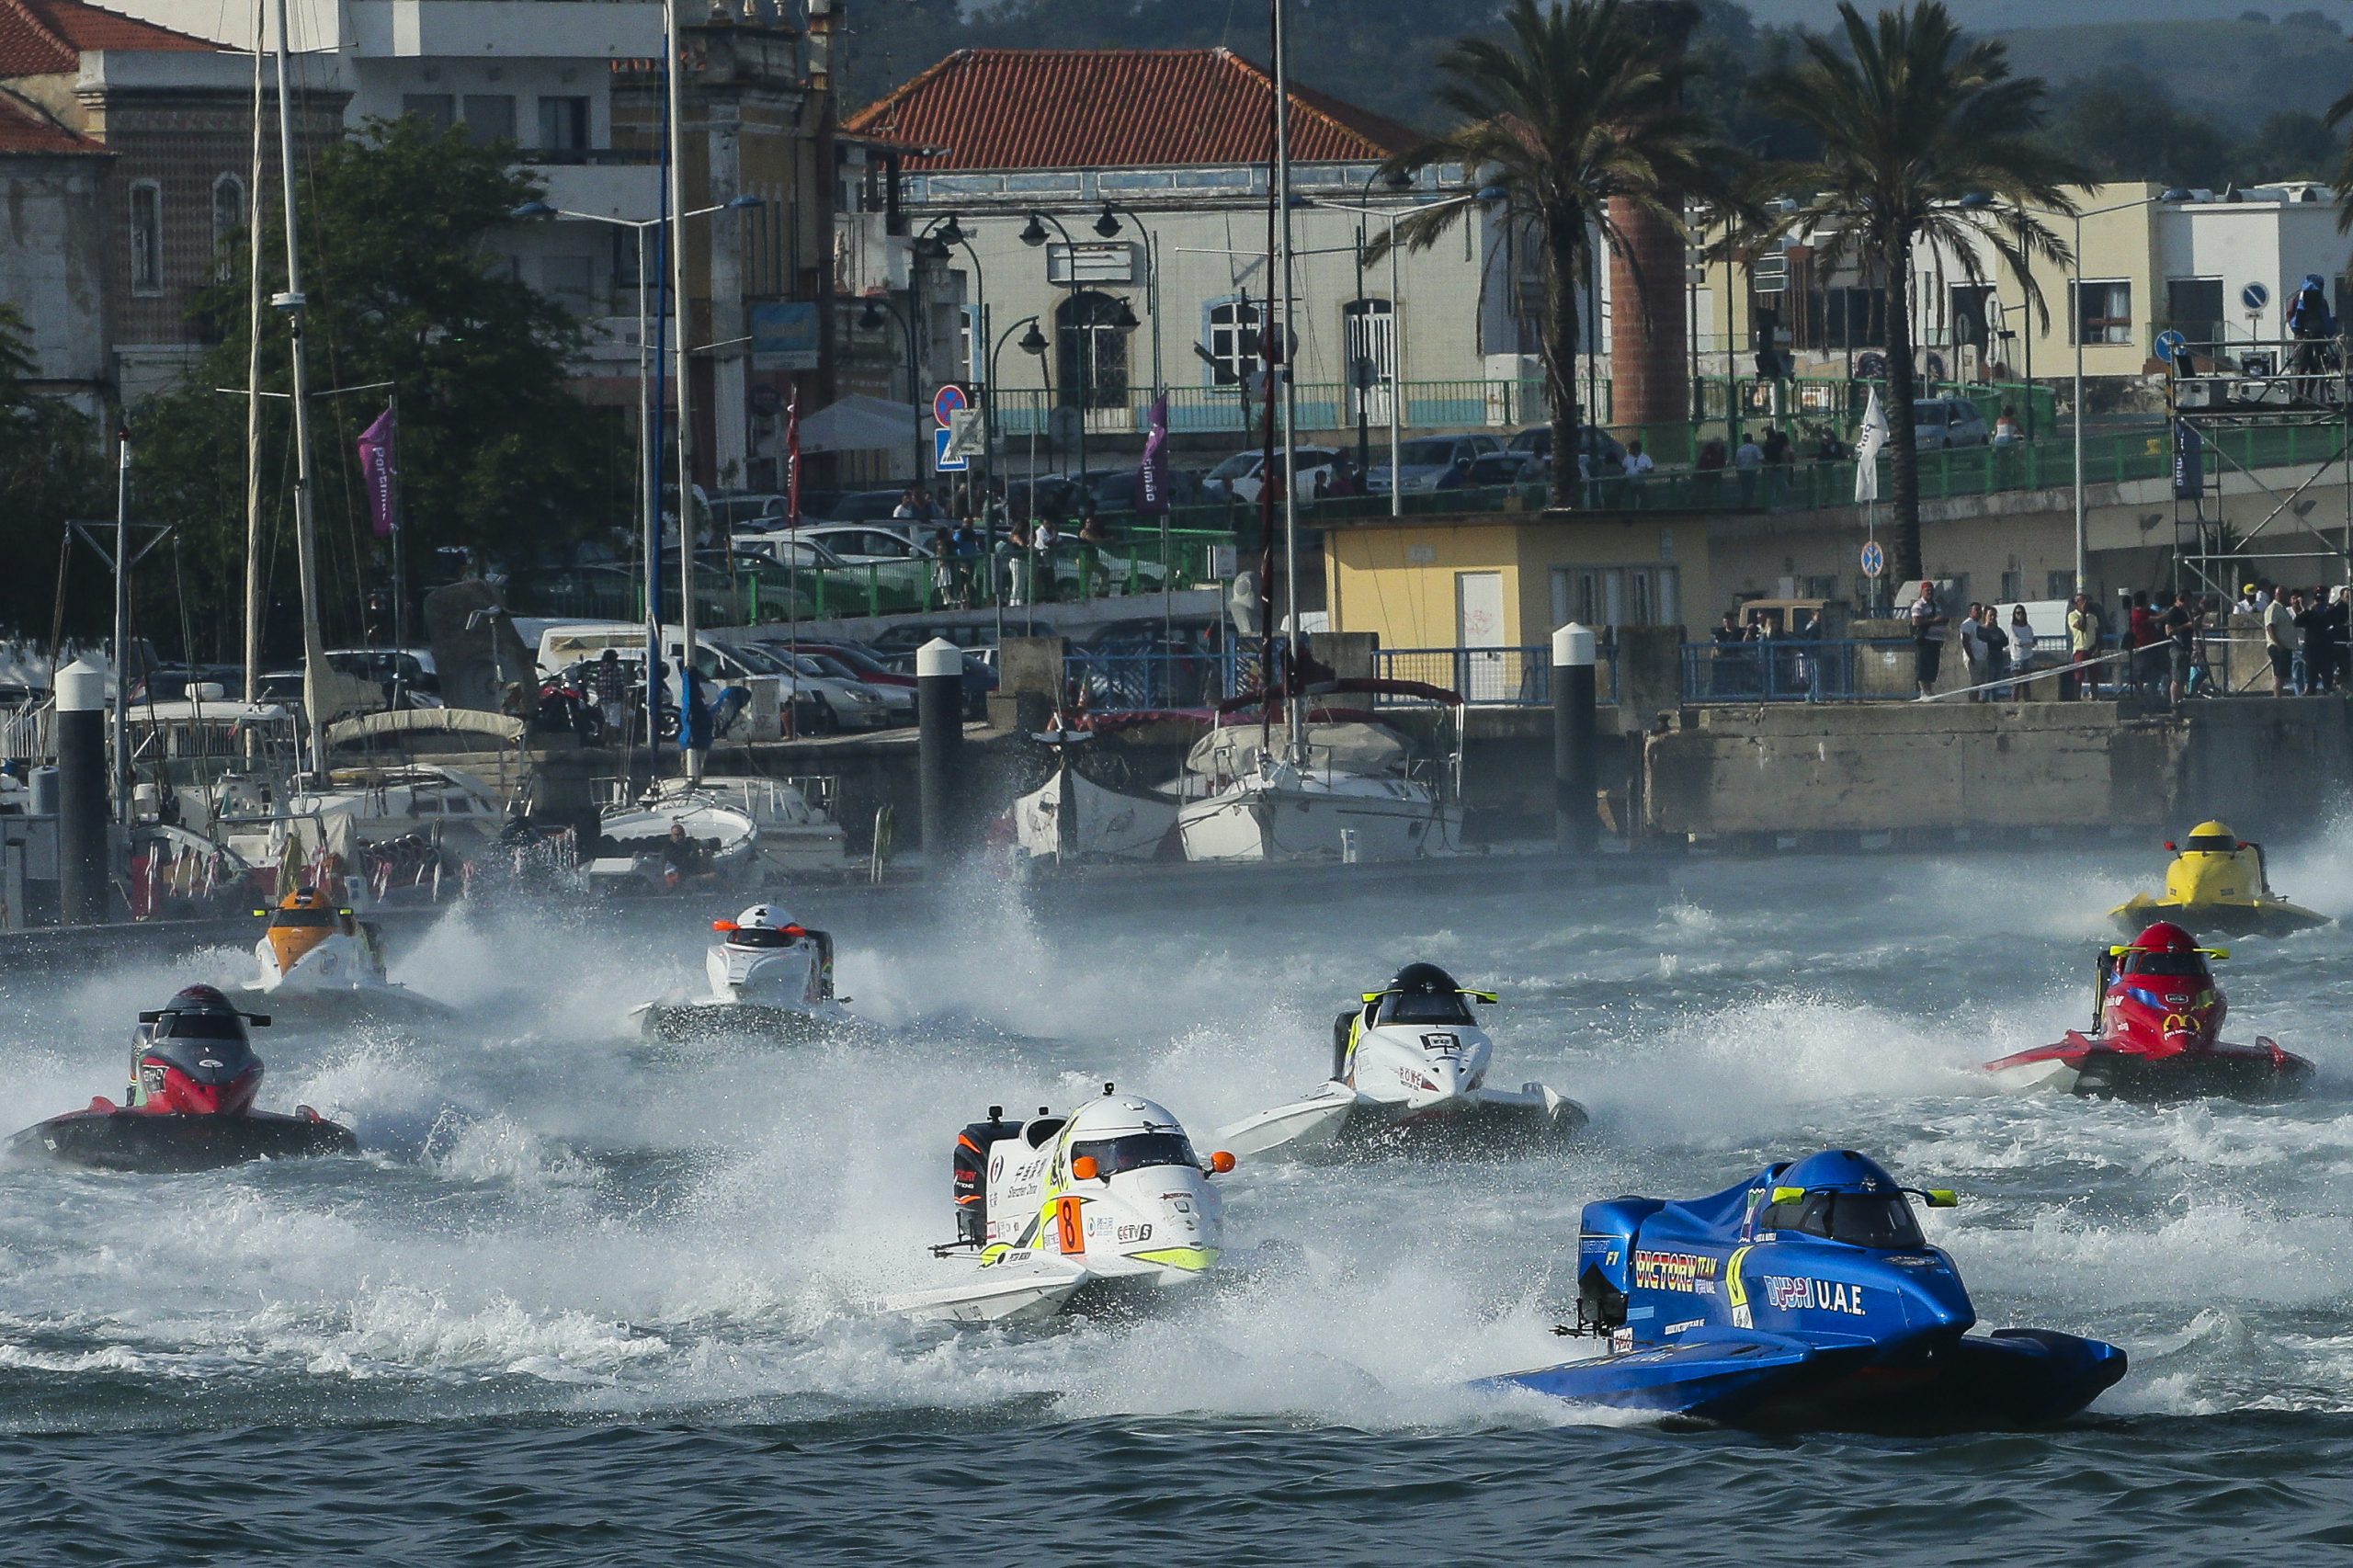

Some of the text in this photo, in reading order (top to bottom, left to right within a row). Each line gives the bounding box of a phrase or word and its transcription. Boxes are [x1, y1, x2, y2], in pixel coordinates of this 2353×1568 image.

[1399, 1066, 1422, 1085] ROWE
[1063, 1199, 1075, 1248] 8
[1635, 1250, 1718, 1292] VICTORY TEAM
[1816, 1280, 1867, 1316] U.A.E.
